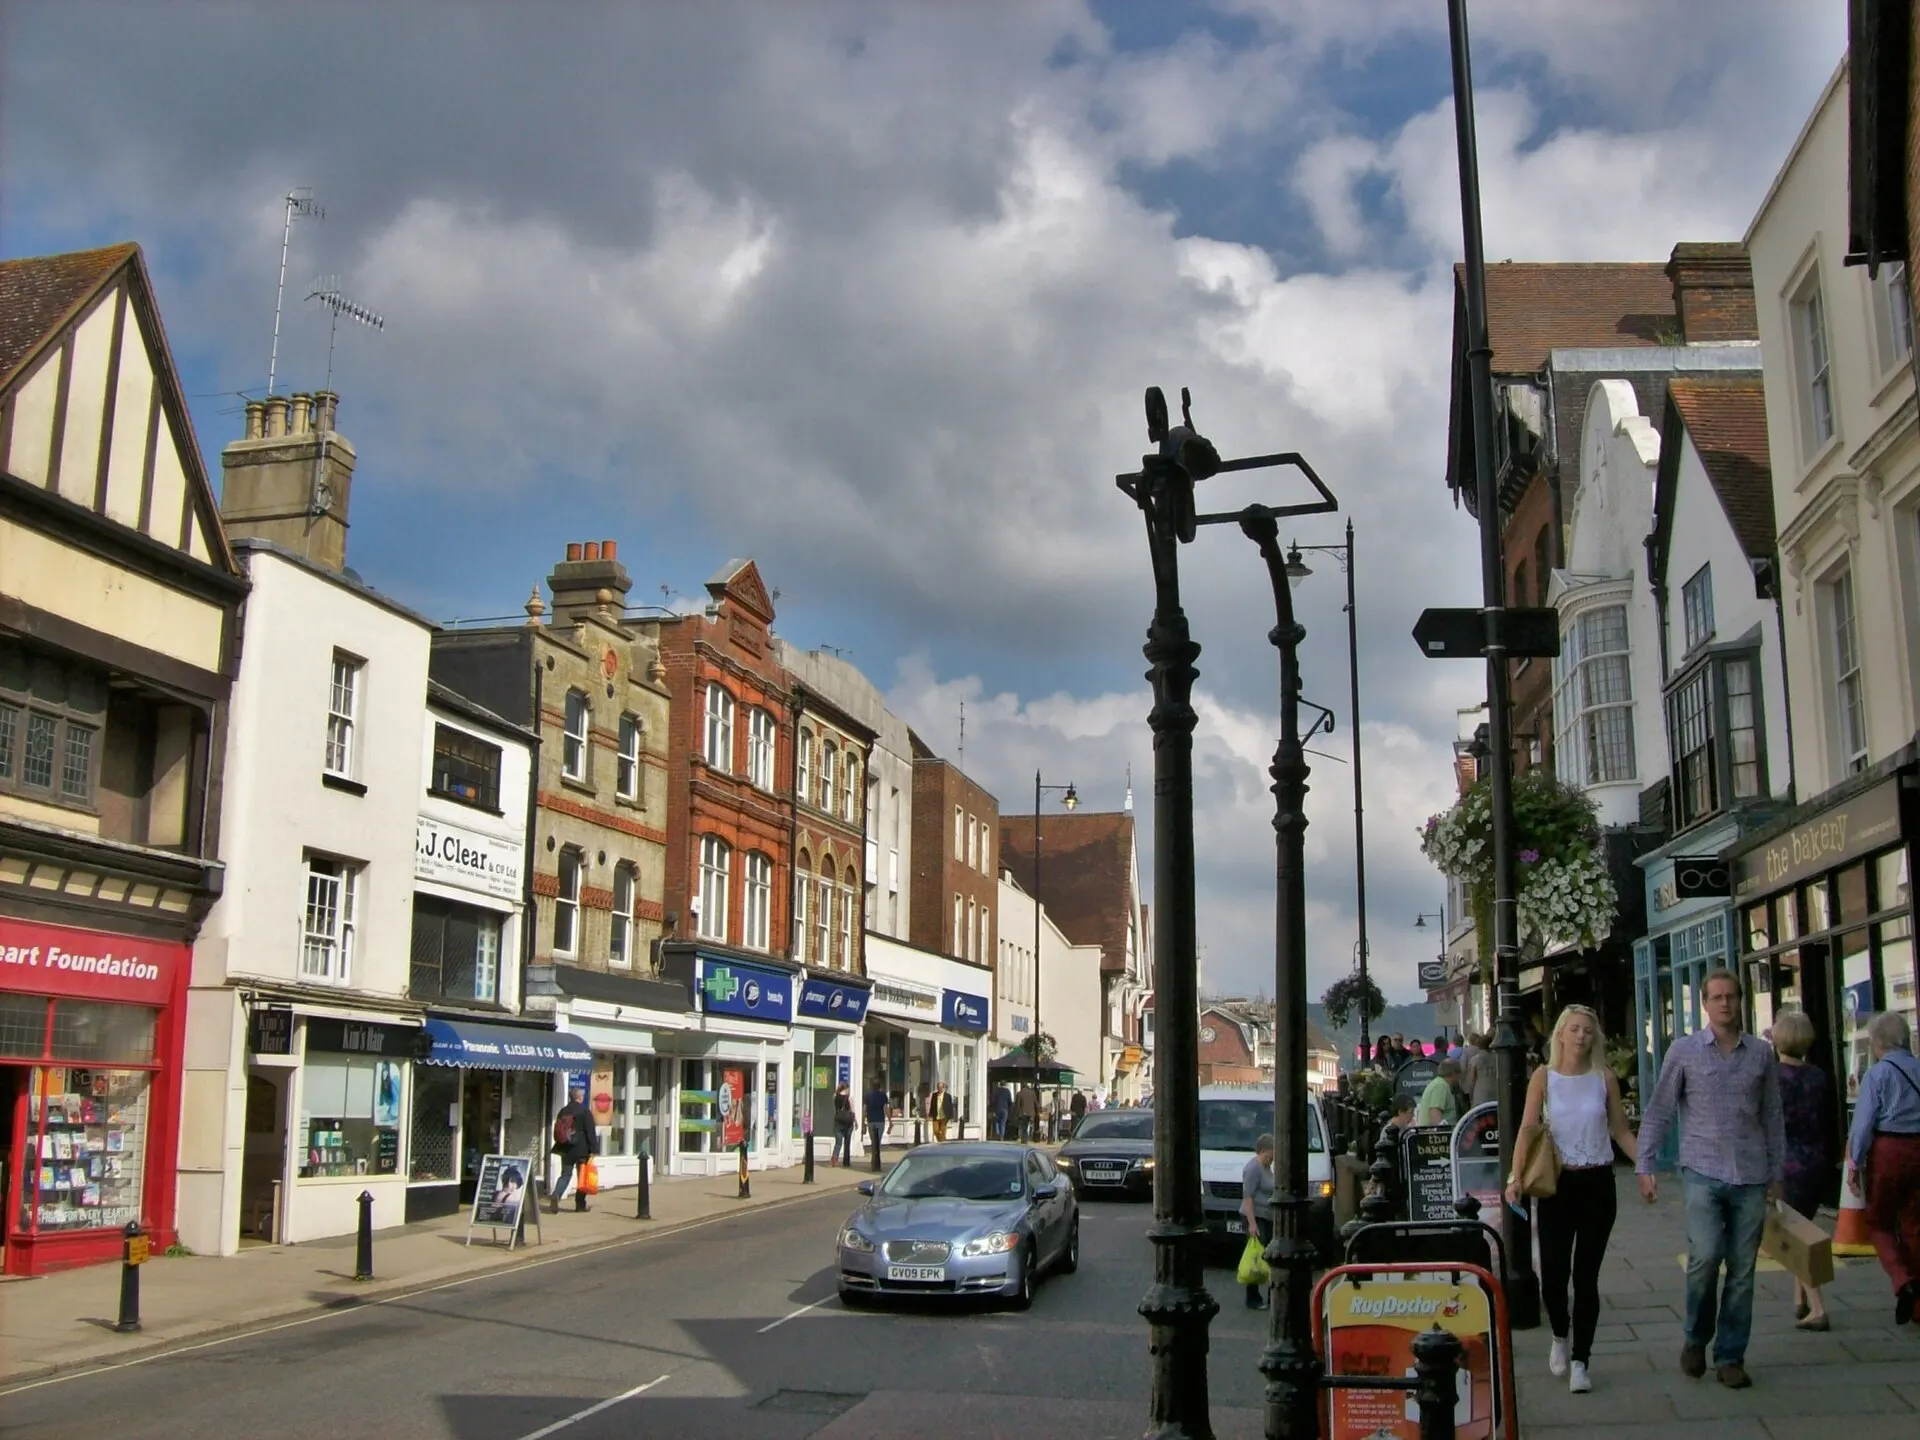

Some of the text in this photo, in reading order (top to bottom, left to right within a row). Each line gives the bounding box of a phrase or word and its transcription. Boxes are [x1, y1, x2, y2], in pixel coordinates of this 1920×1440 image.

[1766, 845, 1790, 882] the
[1792, 813, 1849, 865] bakery
[506, 866, 517, 879] Ltd
[45, 946, 158, 981] Foundation
[258, 1012, 287, 1031] Kim's
[260, 1031, 286, 1052] Hair
[342, 1023, 385, 1053] Kim's Hair
[462, 1039, 500, 1054] Panasonic
[557, 1048, 592, 1061] Panasonic
[1428, 1135, 1448, 1145] the
[891, 1267, 940, 1279] GV09 EPK
[1351, 1296, 1441, 1318] RugDoctor
